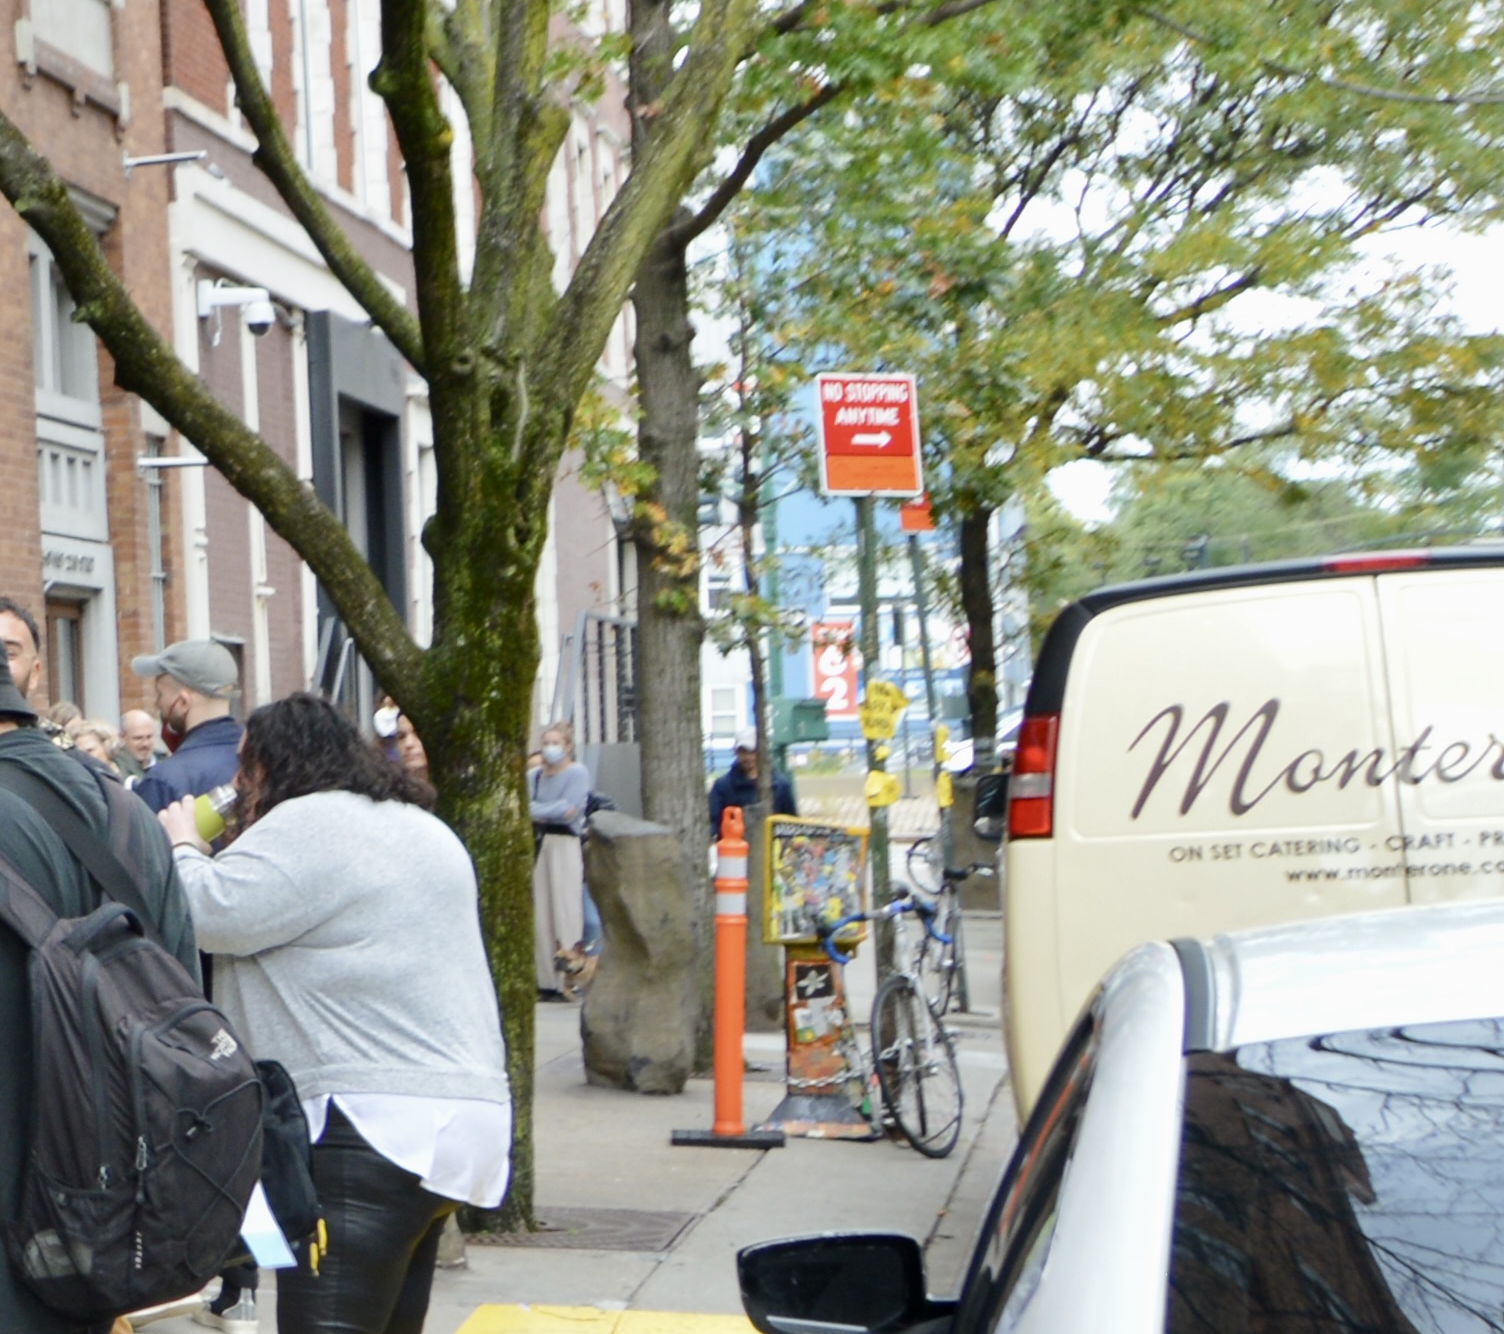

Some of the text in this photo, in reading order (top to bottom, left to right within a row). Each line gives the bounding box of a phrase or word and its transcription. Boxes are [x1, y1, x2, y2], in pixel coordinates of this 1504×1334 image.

[823, 382, 908, 404] NO STOPPING
[835, 407, 899, 426] ANYTIME
[820, 677, 849, 711] 2
[1169, 845, 1202, 863] ON
[1210, 842, 1244, 860] SET
[1250, 837, 1362, 860] CATERING
[1385, 832, 1455, 852] CRAFT
